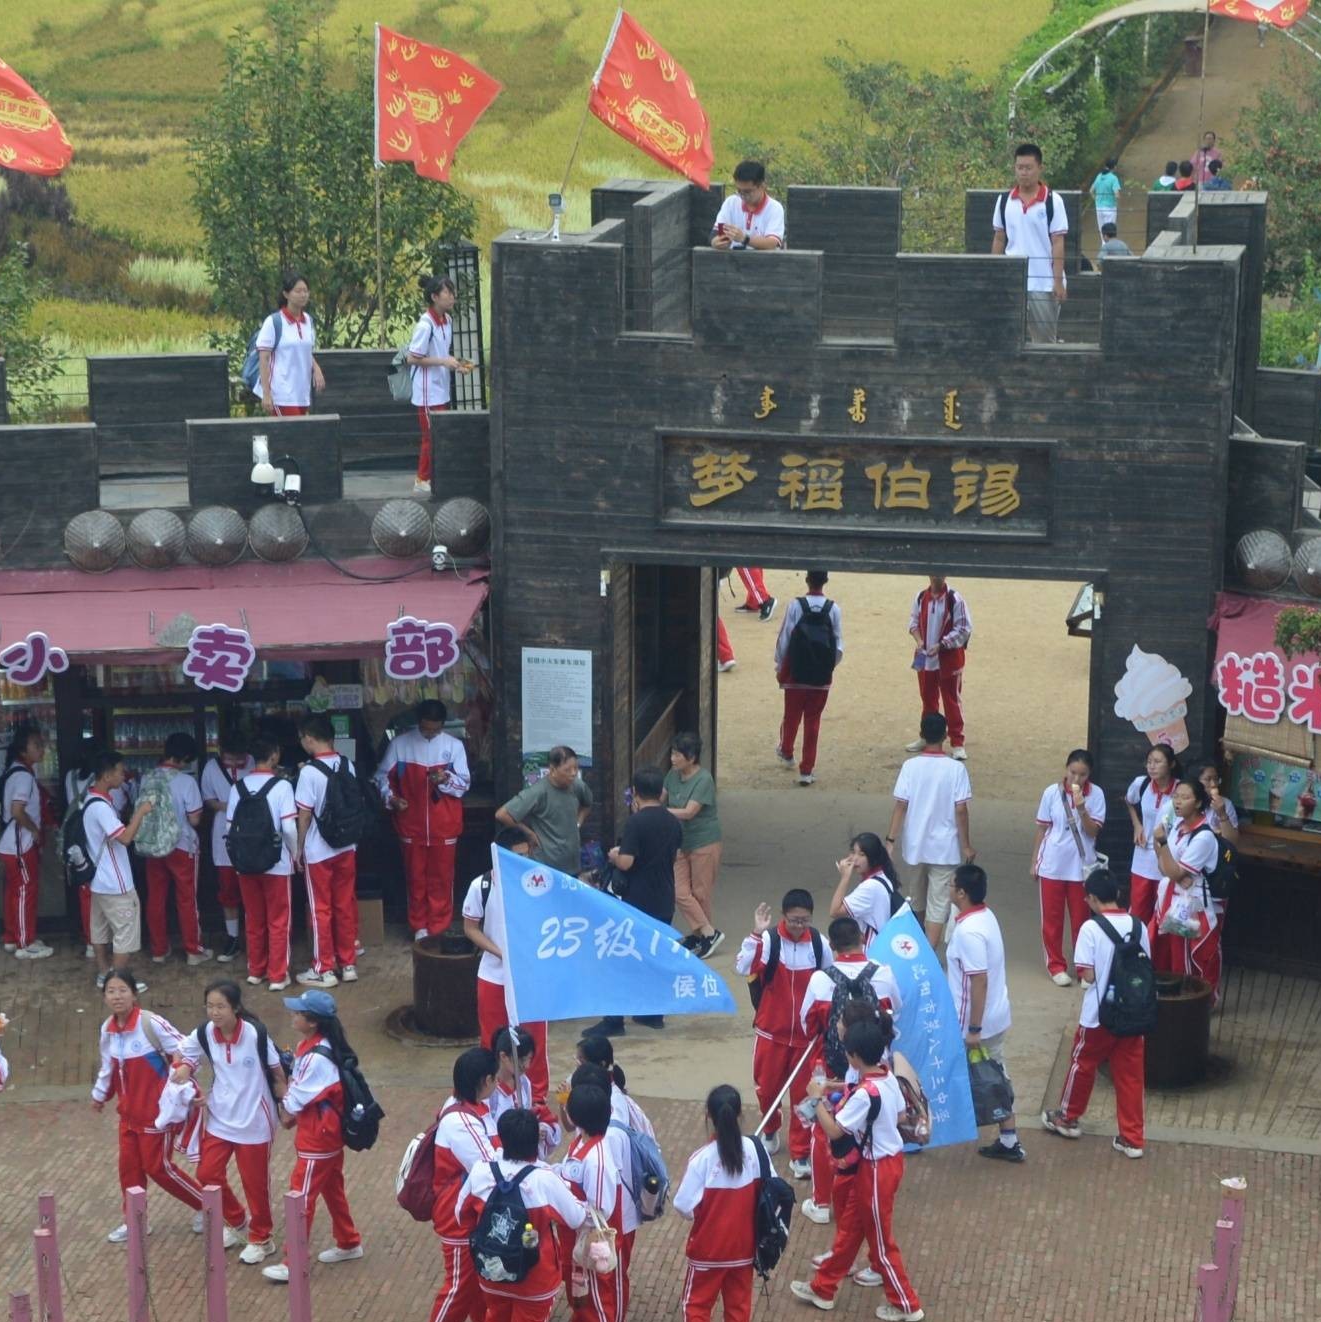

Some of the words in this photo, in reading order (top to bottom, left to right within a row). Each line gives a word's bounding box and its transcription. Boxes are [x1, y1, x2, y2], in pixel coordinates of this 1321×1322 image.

[0, 617, 459, 691] 小卖部
[910, 962, 952, 1124] 沈阳市第八十三中学
